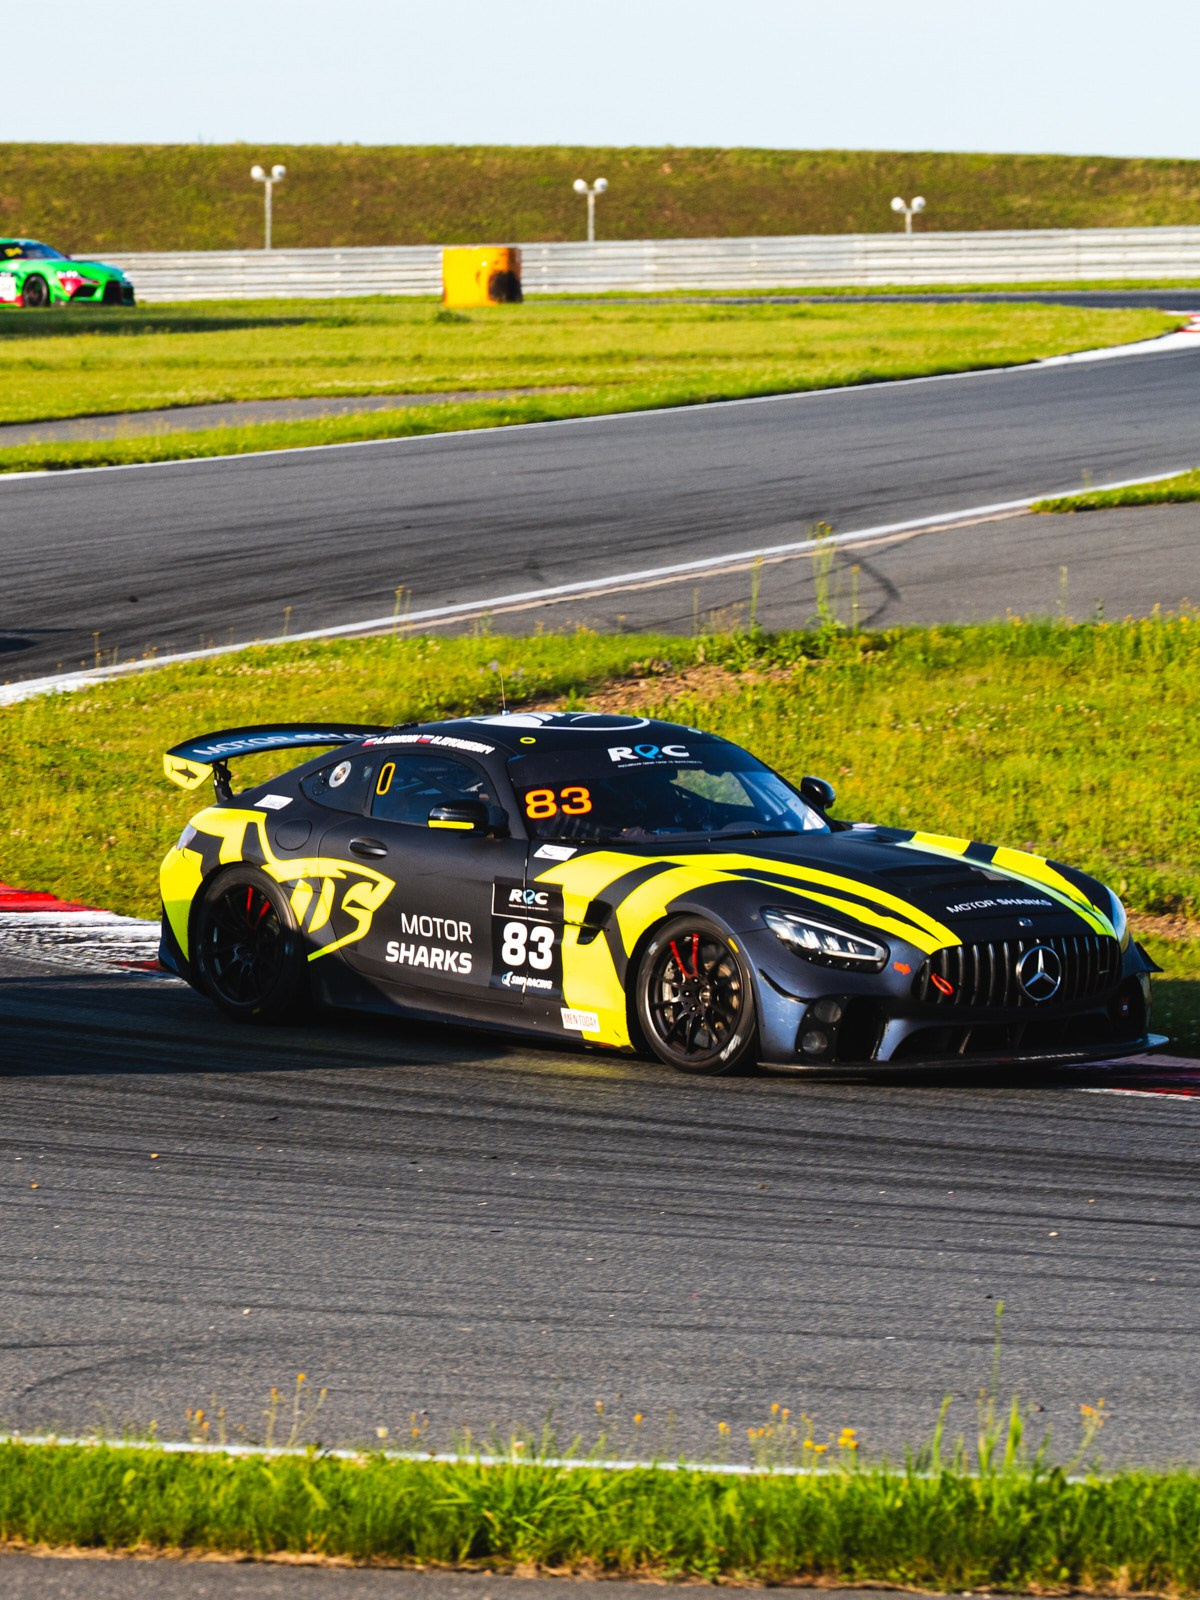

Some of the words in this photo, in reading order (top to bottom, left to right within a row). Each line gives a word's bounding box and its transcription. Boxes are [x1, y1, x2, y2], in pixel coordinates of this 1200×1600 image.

[193, 735, 290, 756] MOTOR
[525, 786, 593, 820] 83
[946, 899, 998, 914] MOTOR
[998, 898, 1053, 907] SHARKS
[401, 912, 473, 944] MOTOR
[385, 941, 473, 974] SHARKS
[501, 921, 555, 970] 83
[527, 977, 553, 990] RACING
[563, 1012, 578, 1025] MEN
[578, 1013, 597, 1028] TODAY
